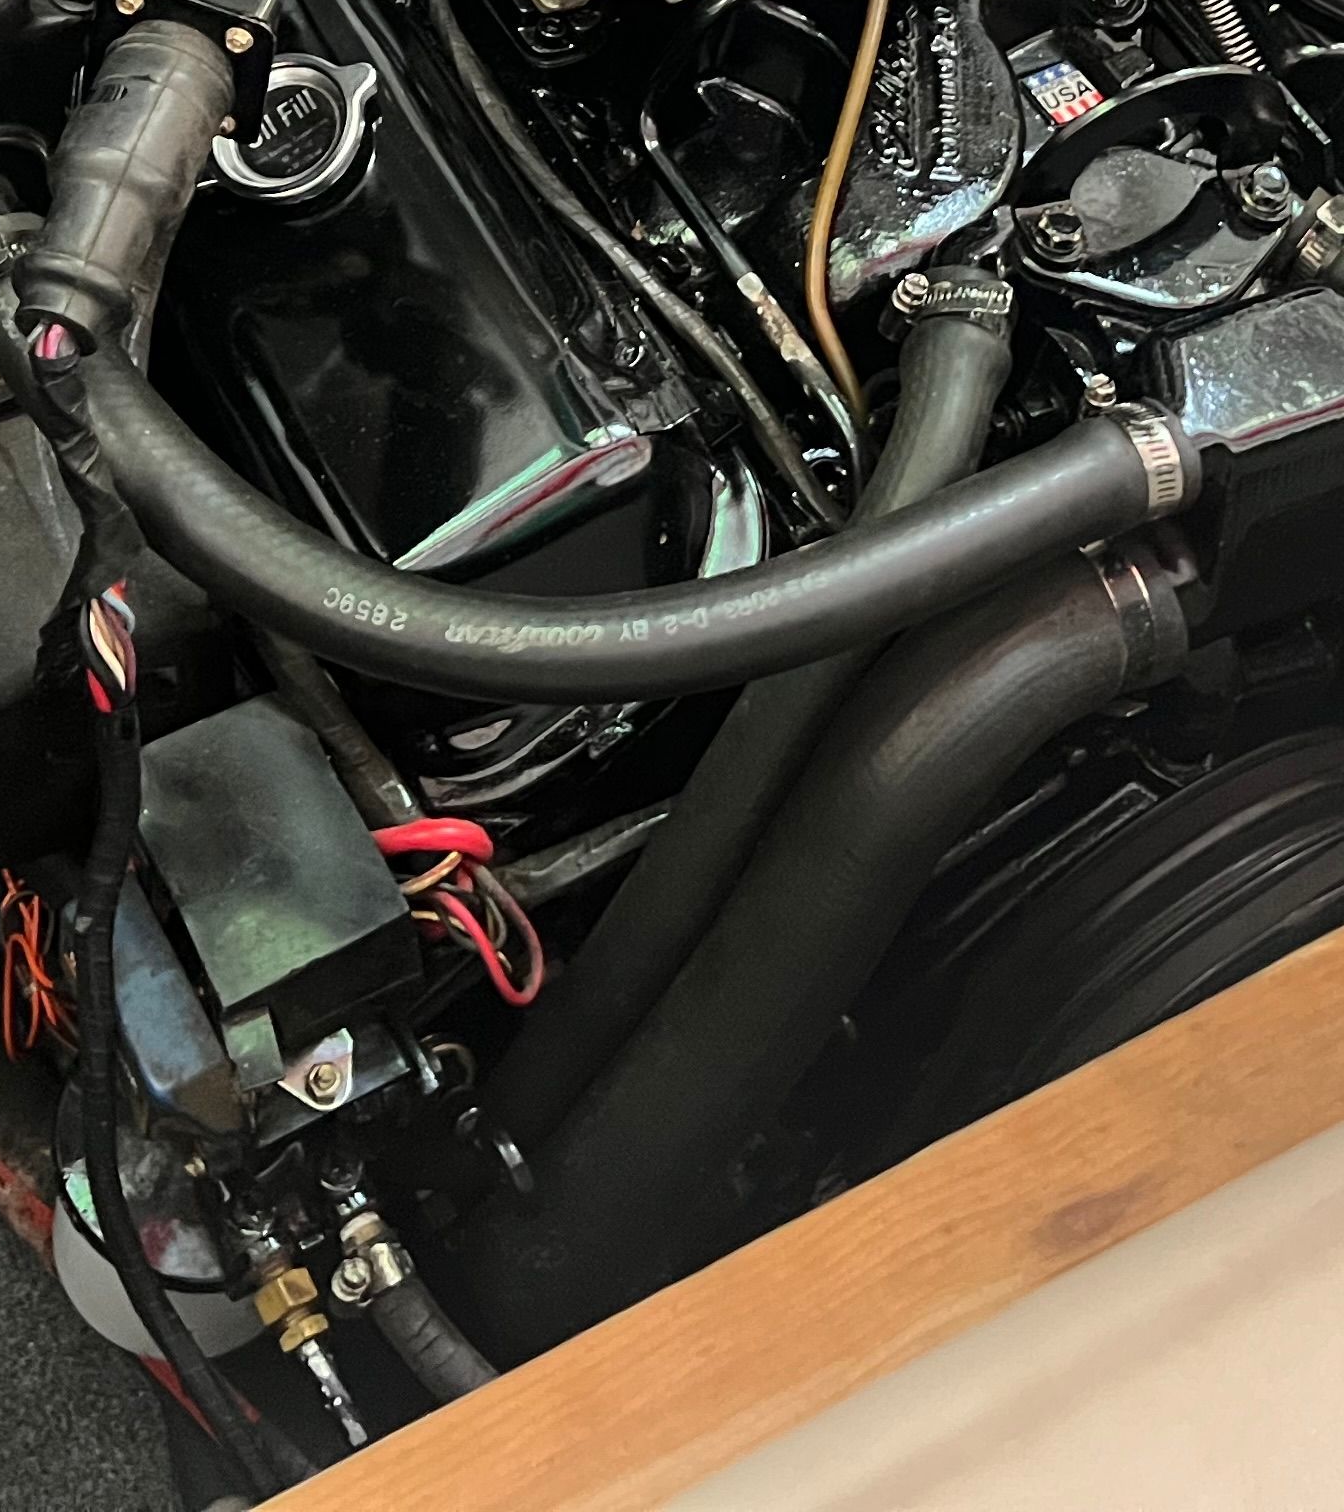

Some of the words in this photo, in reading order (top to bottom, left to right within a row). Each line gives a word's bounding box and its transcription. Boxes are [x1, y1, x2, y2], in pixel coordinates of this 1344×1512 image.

[276, 88, 317, 127] Fill
[1039, 79, 1094, 111] USA
[323, 586, 406, 631] 2859C
[619, 618, 654, 642] BY
